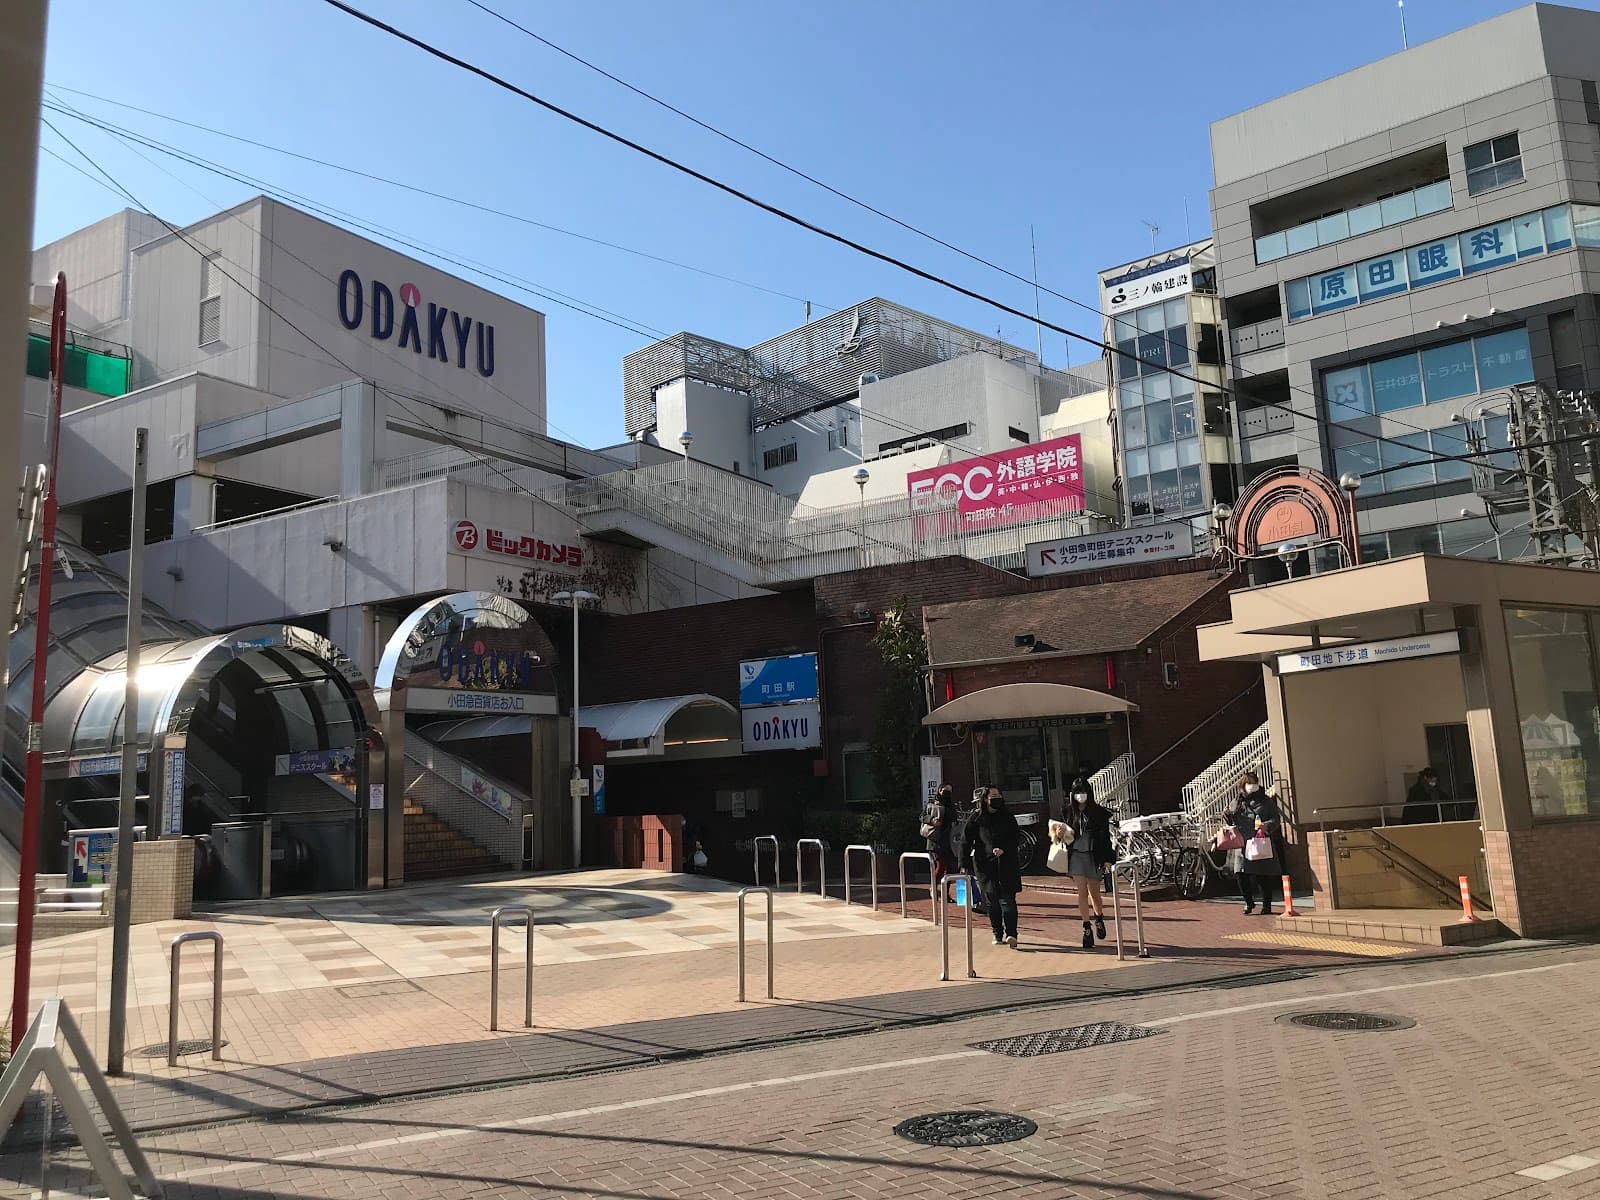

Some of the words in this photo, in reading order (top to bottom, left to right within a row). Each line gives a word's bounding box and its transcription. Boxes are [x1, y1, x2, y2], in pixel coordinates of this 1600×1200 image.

[1319, 228, 1503, 301] 原田眼科
[1128, 274, 1188, 301] 三ノ輪建設
[338, 269, 495, 378] ODAKYU
[911, 466, 994, 511] ECC
[997, 446, 1078, 482] 外語学院
[485, 528, 583, 568] ビックカメラ
[1059, 530, 1174, 555] 小田急町田テニススクール
[1060, 547, 1136, 566] スクール生募集中
[438, 641, 531, 688] ODAKYU
[1300, 648, 1369, 668] 町田地下歩道
[761, 681, 796, 695] 町田駅
[447, 693, 525, 711] 小田急百貨店お入口
[752, 716, 809, 741] ODAKYU
